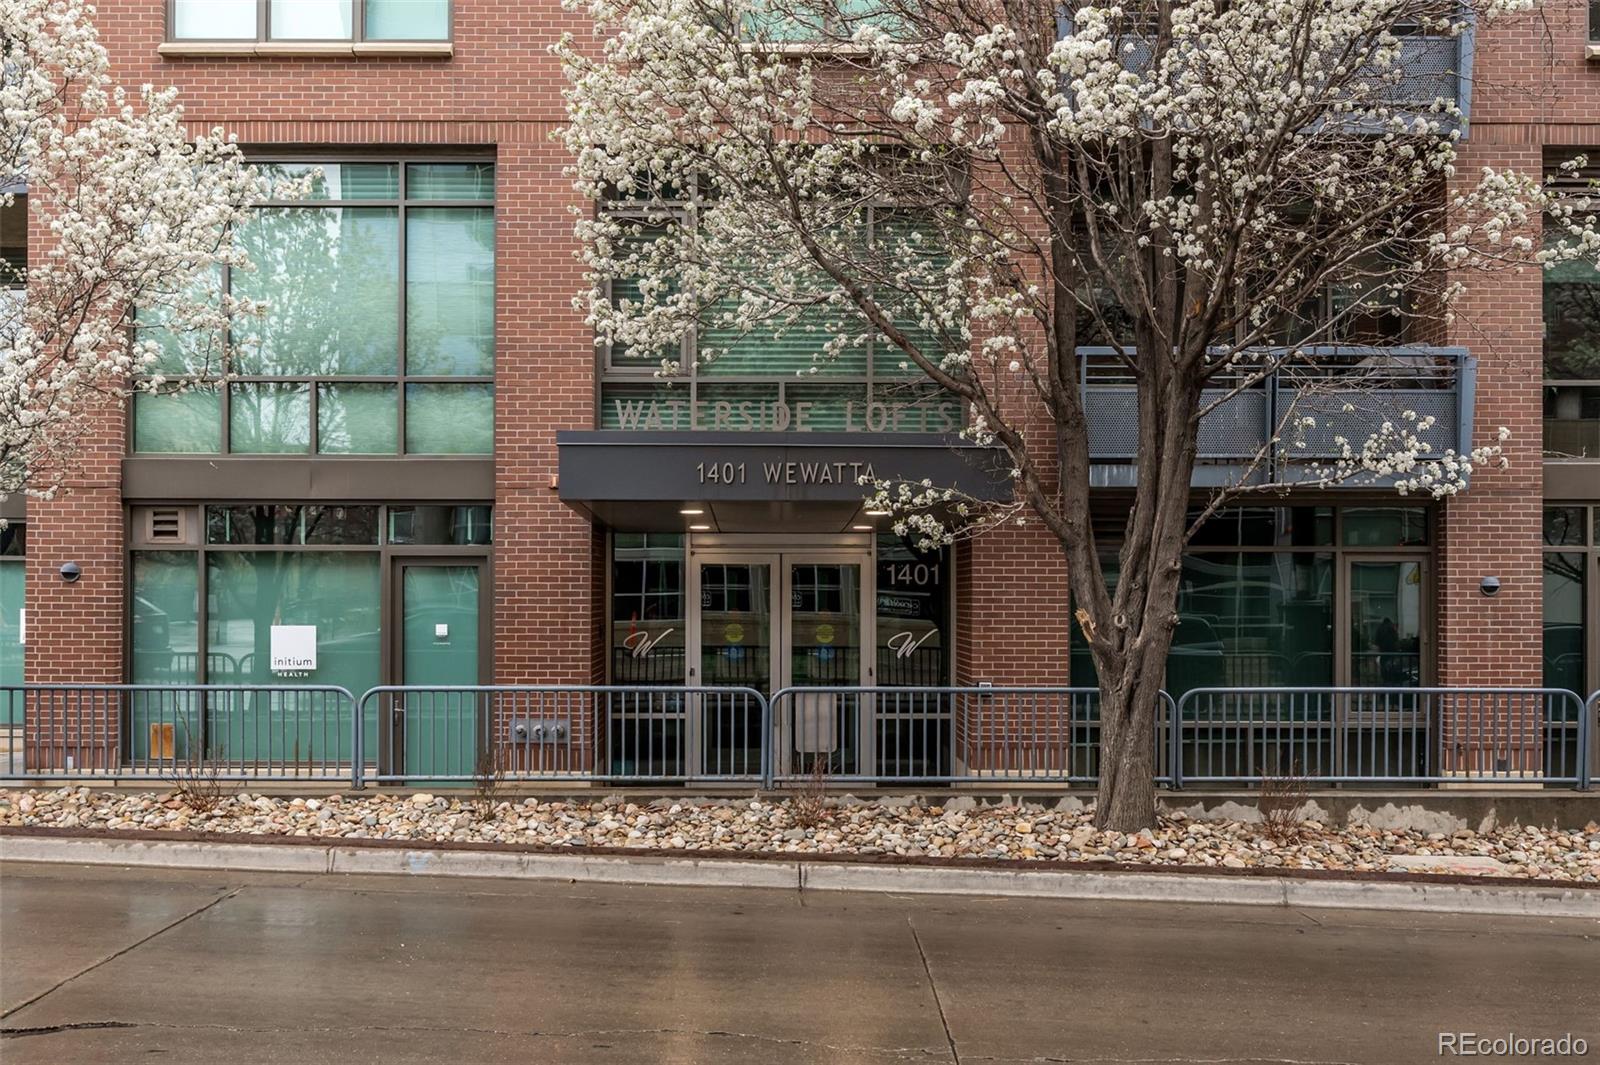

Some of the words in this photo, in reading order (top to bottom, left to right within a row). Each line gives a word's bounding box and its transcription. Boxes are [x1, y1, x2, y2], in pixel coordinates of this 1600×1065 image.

[615, 400, 813, 432] WATERSIDE
[846, 402, 953, 433] LOFTS
[697, 462, 746, 484] 1401
[763, 462, 876, 484] WEWATTA
[887, 563, 939, 585] 1401
[623, 628, 674, 658] W
[887, 628, 938, 659] W
[274, 657, 312, 666] initium
